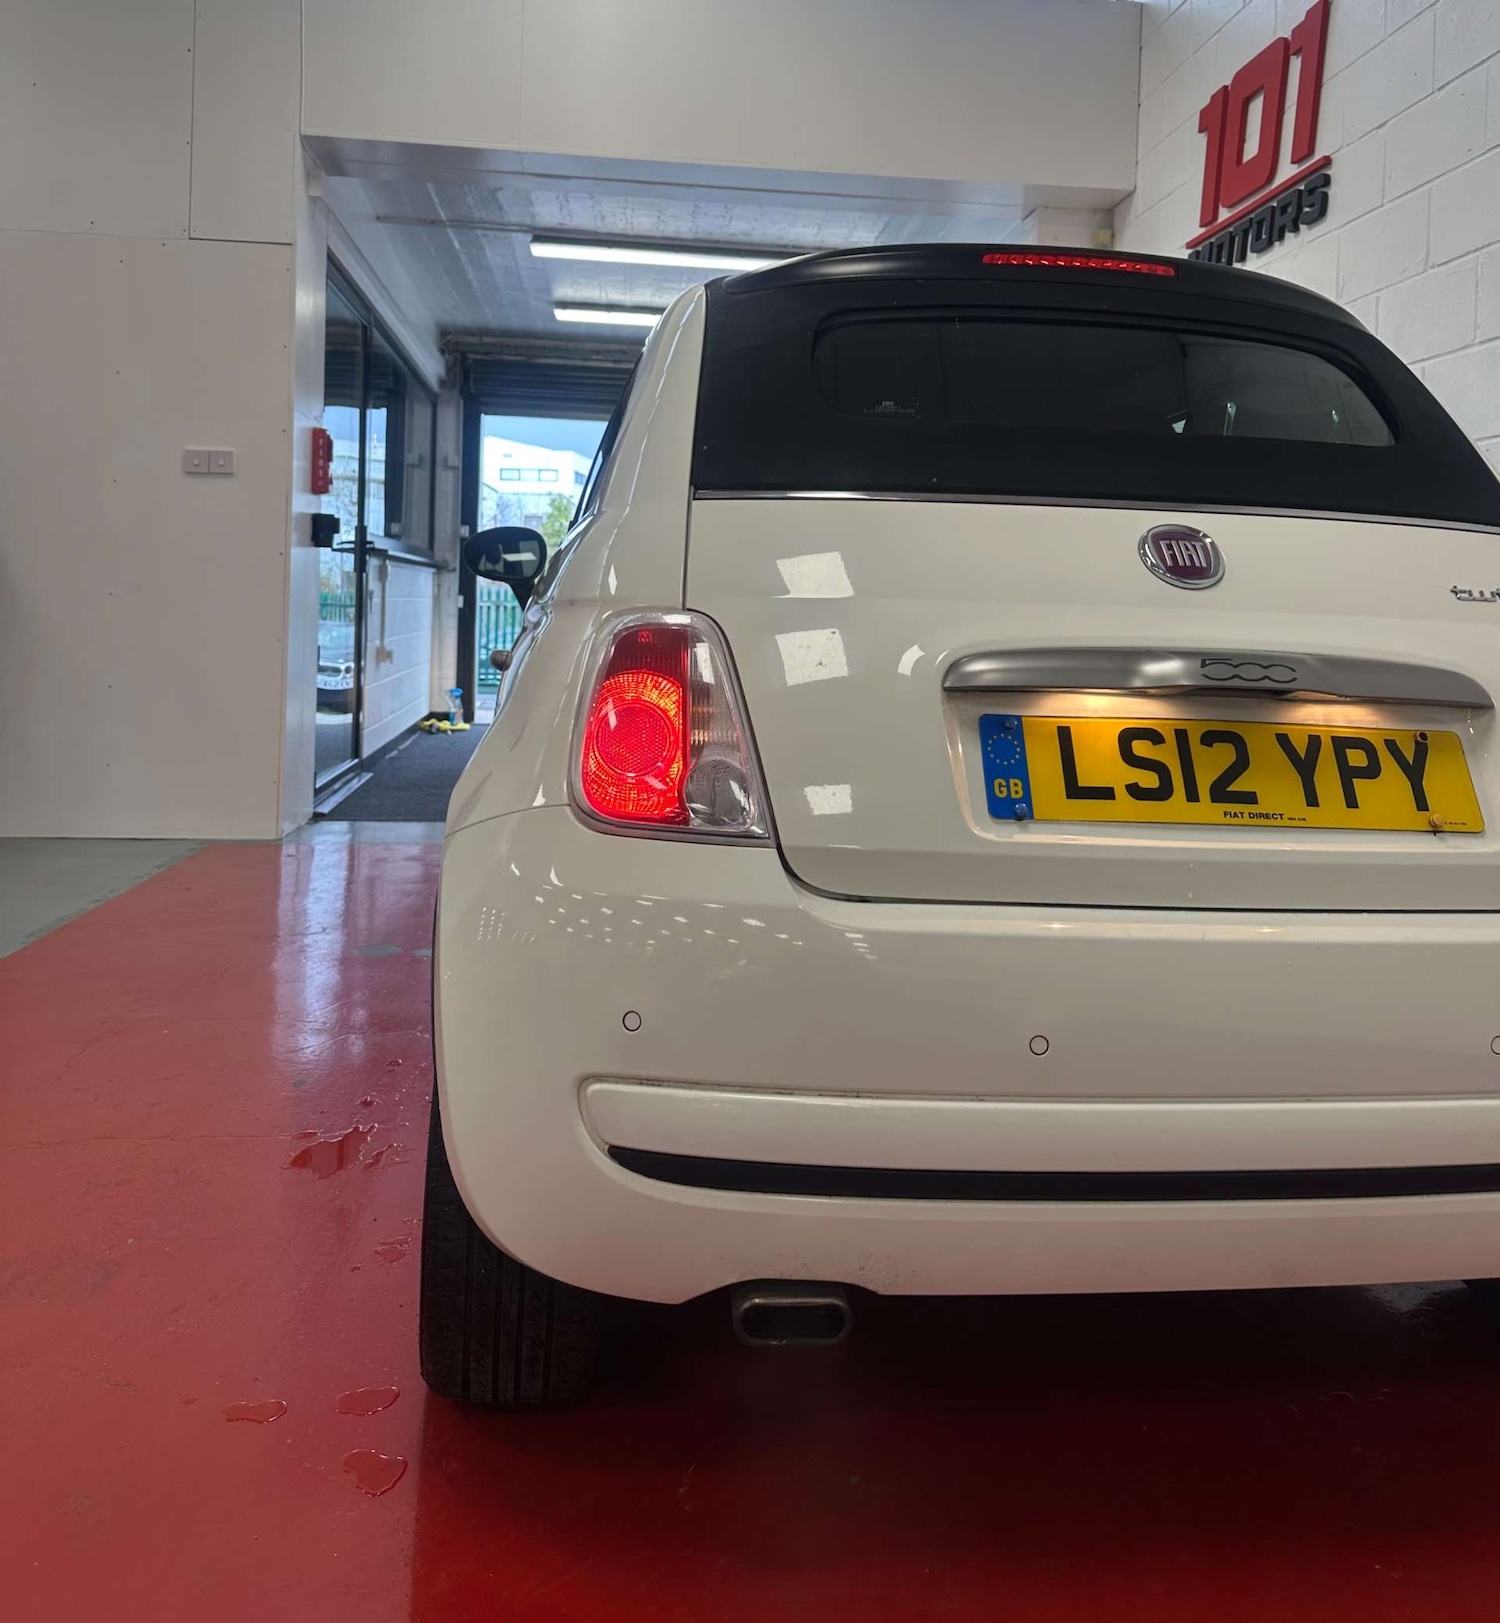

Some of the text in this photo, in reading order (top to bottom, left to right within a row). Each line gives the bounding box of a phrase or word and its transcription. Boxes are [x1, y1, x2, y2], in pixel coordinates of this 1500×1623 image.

[1198, 0, 1330, 228] 101
[1159, 540, 1207, 567] FIAT
[1200, 658, 1297, 683] 500
[1056, 725, 1430, 812] LS12 YPY
[994, 778, 1023, 799] GB
[1223, 811, 1244, 819] FIAT
[1248, 812, 1284, 820] DIRECT
